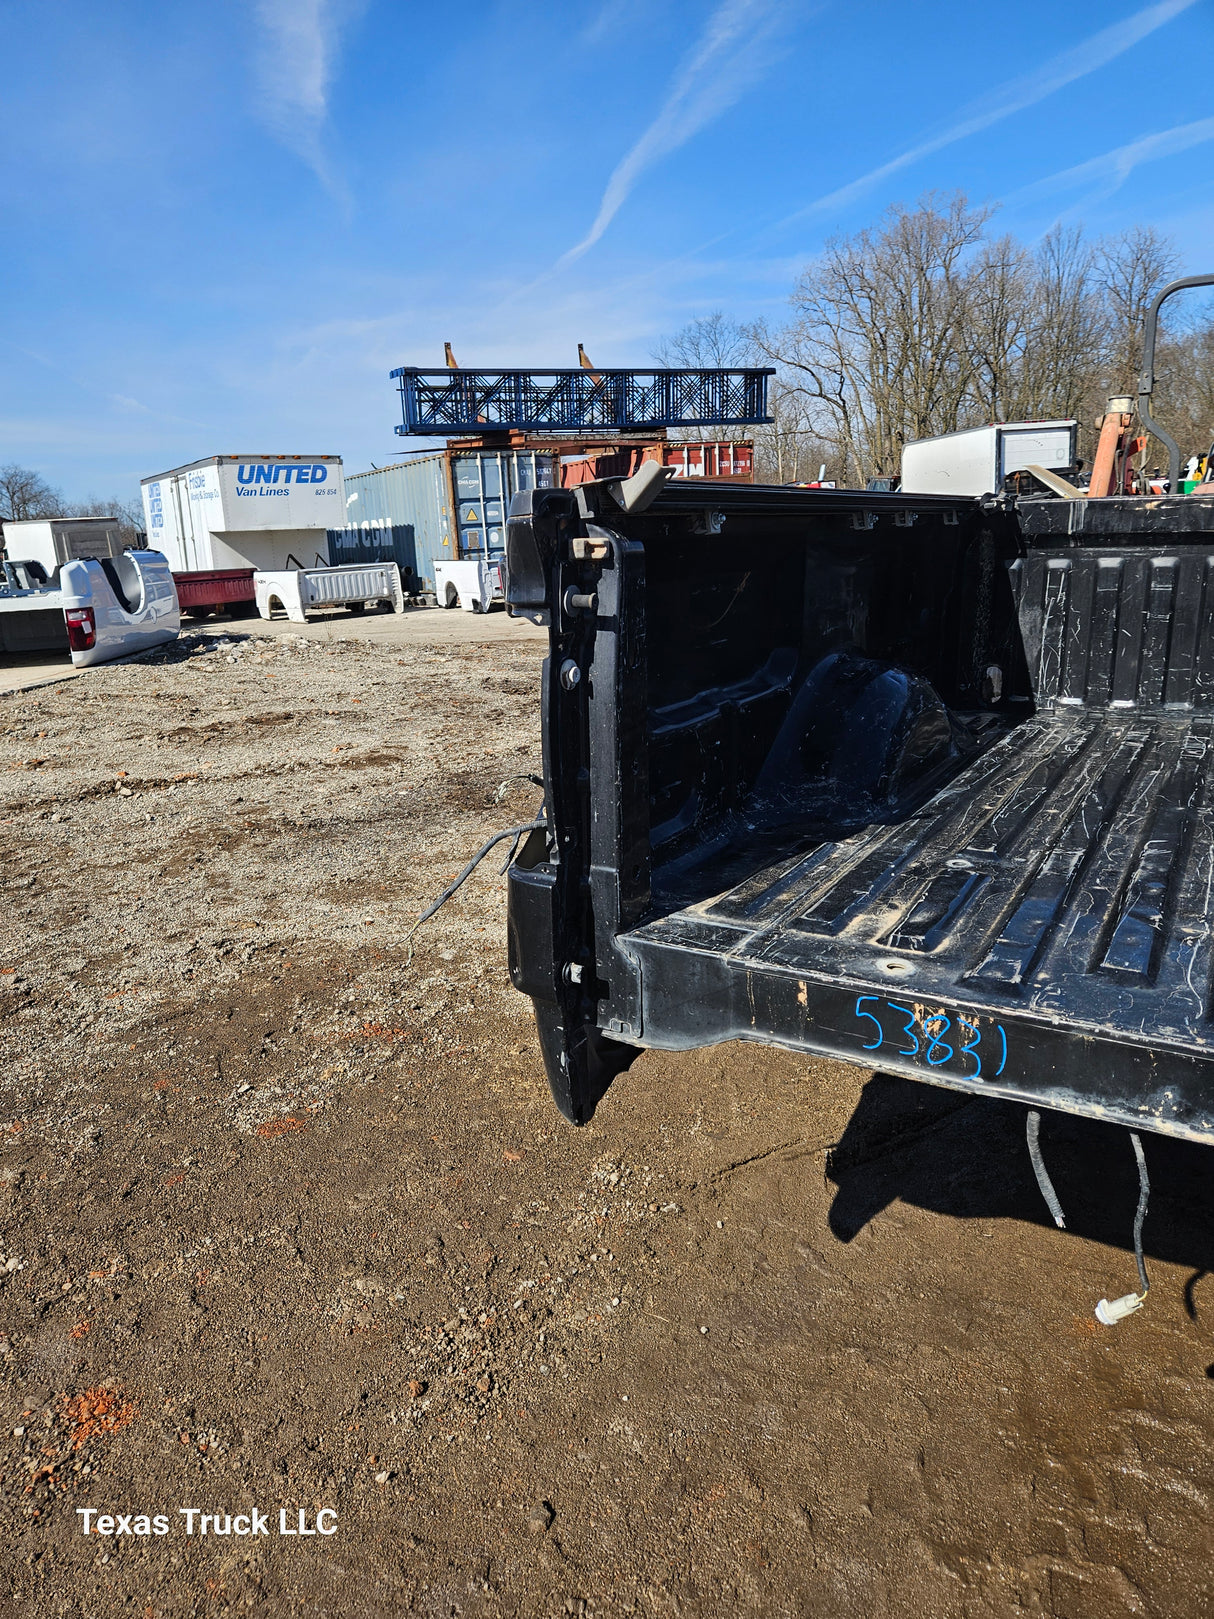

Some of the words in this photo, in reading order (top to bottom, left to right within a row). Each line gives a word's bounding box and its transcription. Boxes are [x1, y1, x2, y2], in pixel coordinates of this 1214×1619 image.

[237, 464, 328, 485] UNITED
[236, 487, 257, 496] Van
[259, 486, 290, 496] Lines
[333, 521, 359, 549] CMA
[361, 517, 394, 548] CGM
[856, 995, 1008, 1081] 53831
